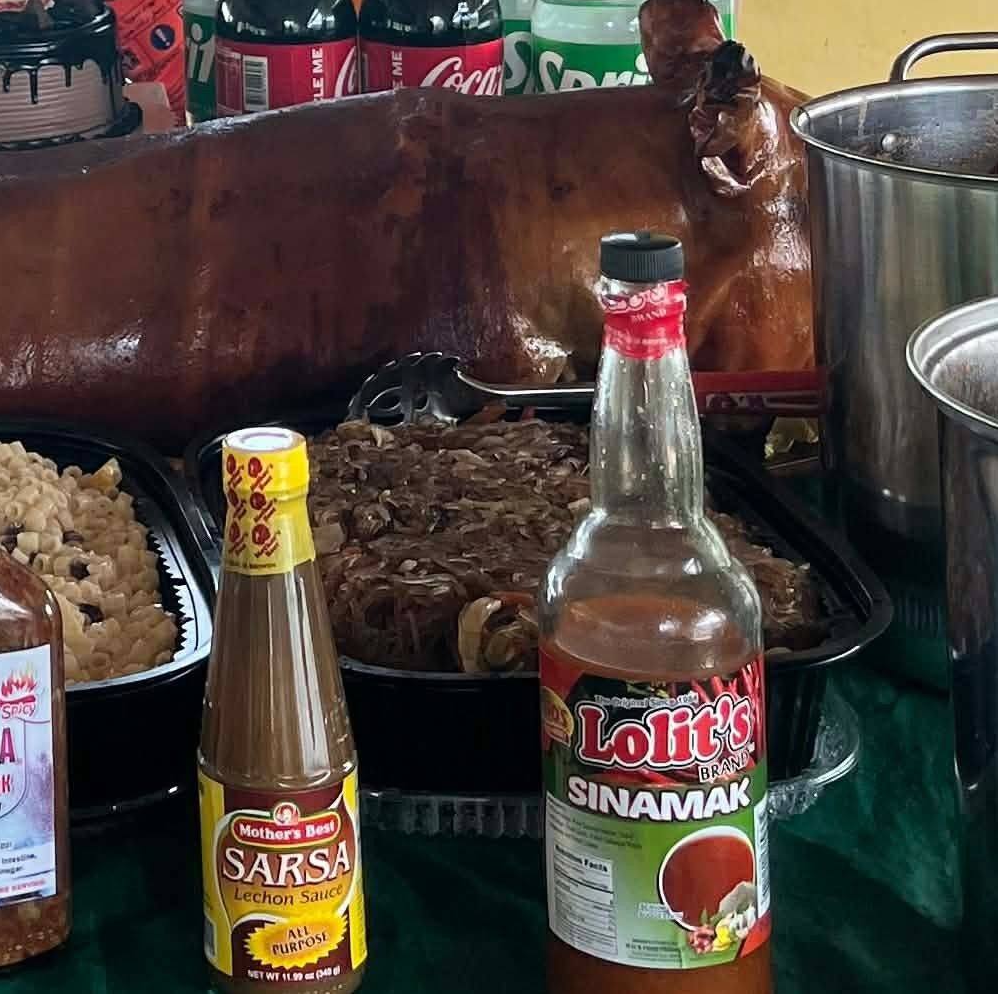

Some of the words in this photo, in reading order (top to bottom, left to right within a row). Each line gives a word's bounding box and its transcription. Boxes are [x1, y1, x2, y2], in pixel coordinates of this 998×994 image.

[537, 51, 652, 95] Spri
[578, 693, 751, 768] Lolit's
[699, 750, 750, 782] BRAND
[567, 774, 751, 821] SINAMAK
[239, 822, 302, 841] Mother's
[305, 819, 336, 838] Best
[222, 840, 351, 887] SARSA
[234, 886, 294, 907] Lechon
[299, 883, 344, 905] Sauce
[271, 931, 328, 956] PURPOSE
[288, 925, 309, 940] ALL
[247, 969, 264, 980] NET
[266, 971, 280, 982] WT
